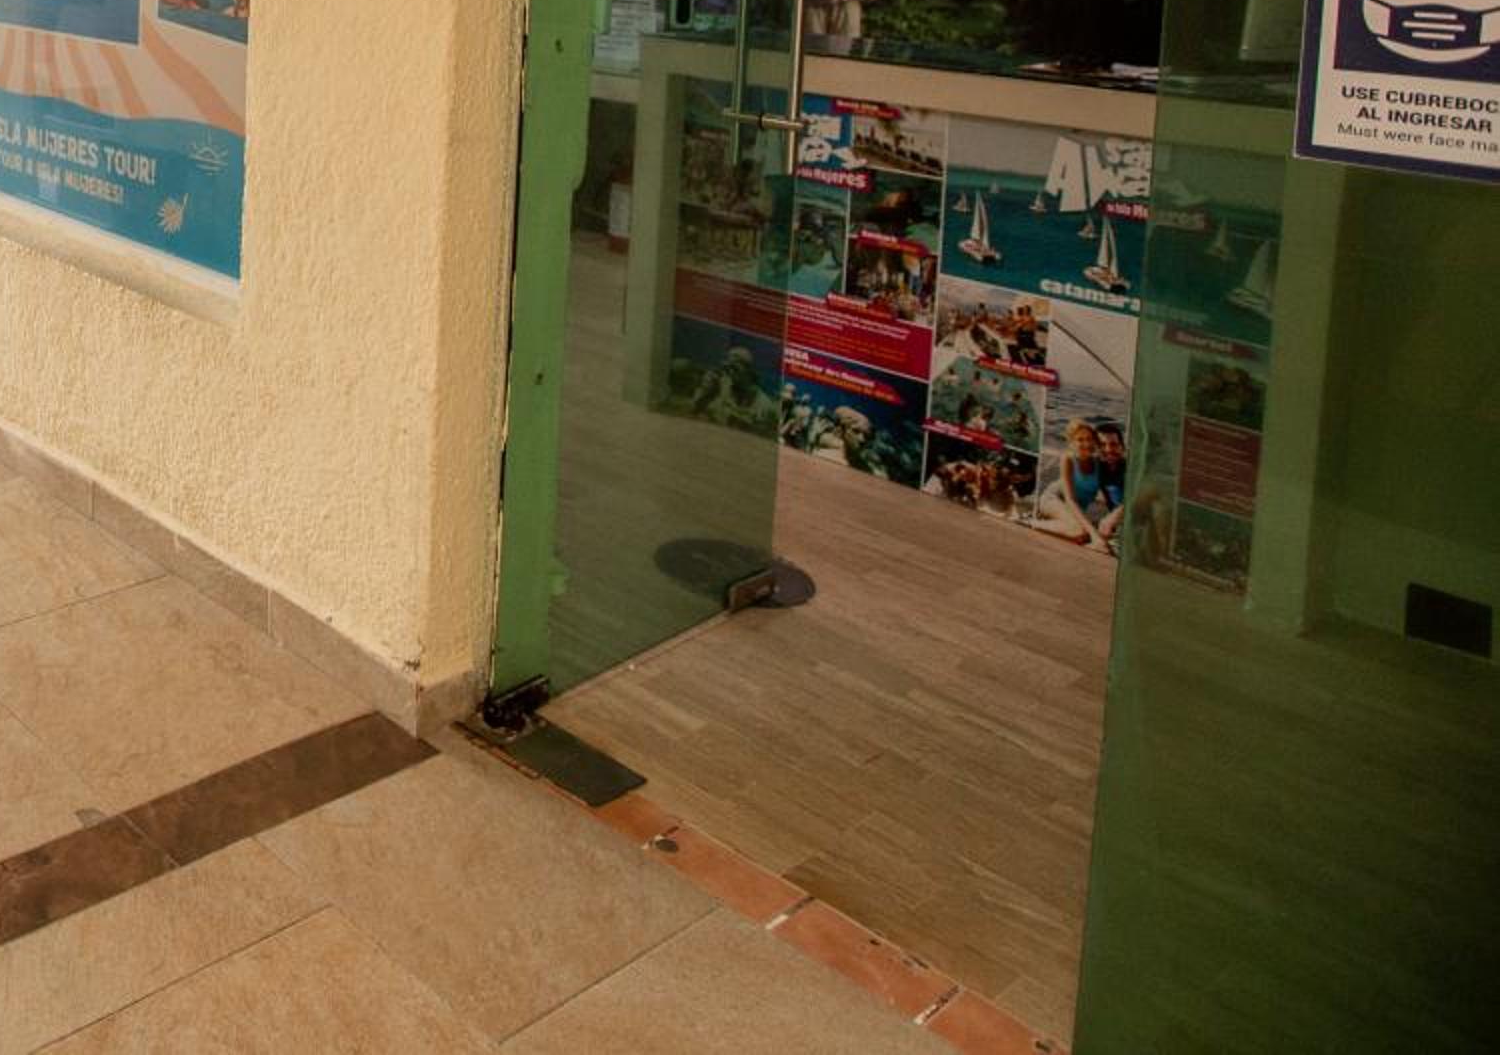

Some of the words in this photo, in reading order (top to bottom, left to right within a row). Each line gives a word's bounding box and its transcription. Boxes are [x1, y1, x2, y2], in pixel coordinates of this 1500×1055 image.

[1341, 85, 1381, 101] USE
[1385, 89, 1499, 114] CUBREBOC
[1356, 106, 1381, 121] AL
[1387, 108, 1493, 134] INGRESAR
[1337, 122, 1378, 138] Must
[1383, 129, 1423, 145] were
[1428, 132, 1465, 150] face
[26, 128, 100, 168] MUJERES
[103, 147, 157, 185] TOUR!
[36, 160, 61, 185] ISLA
